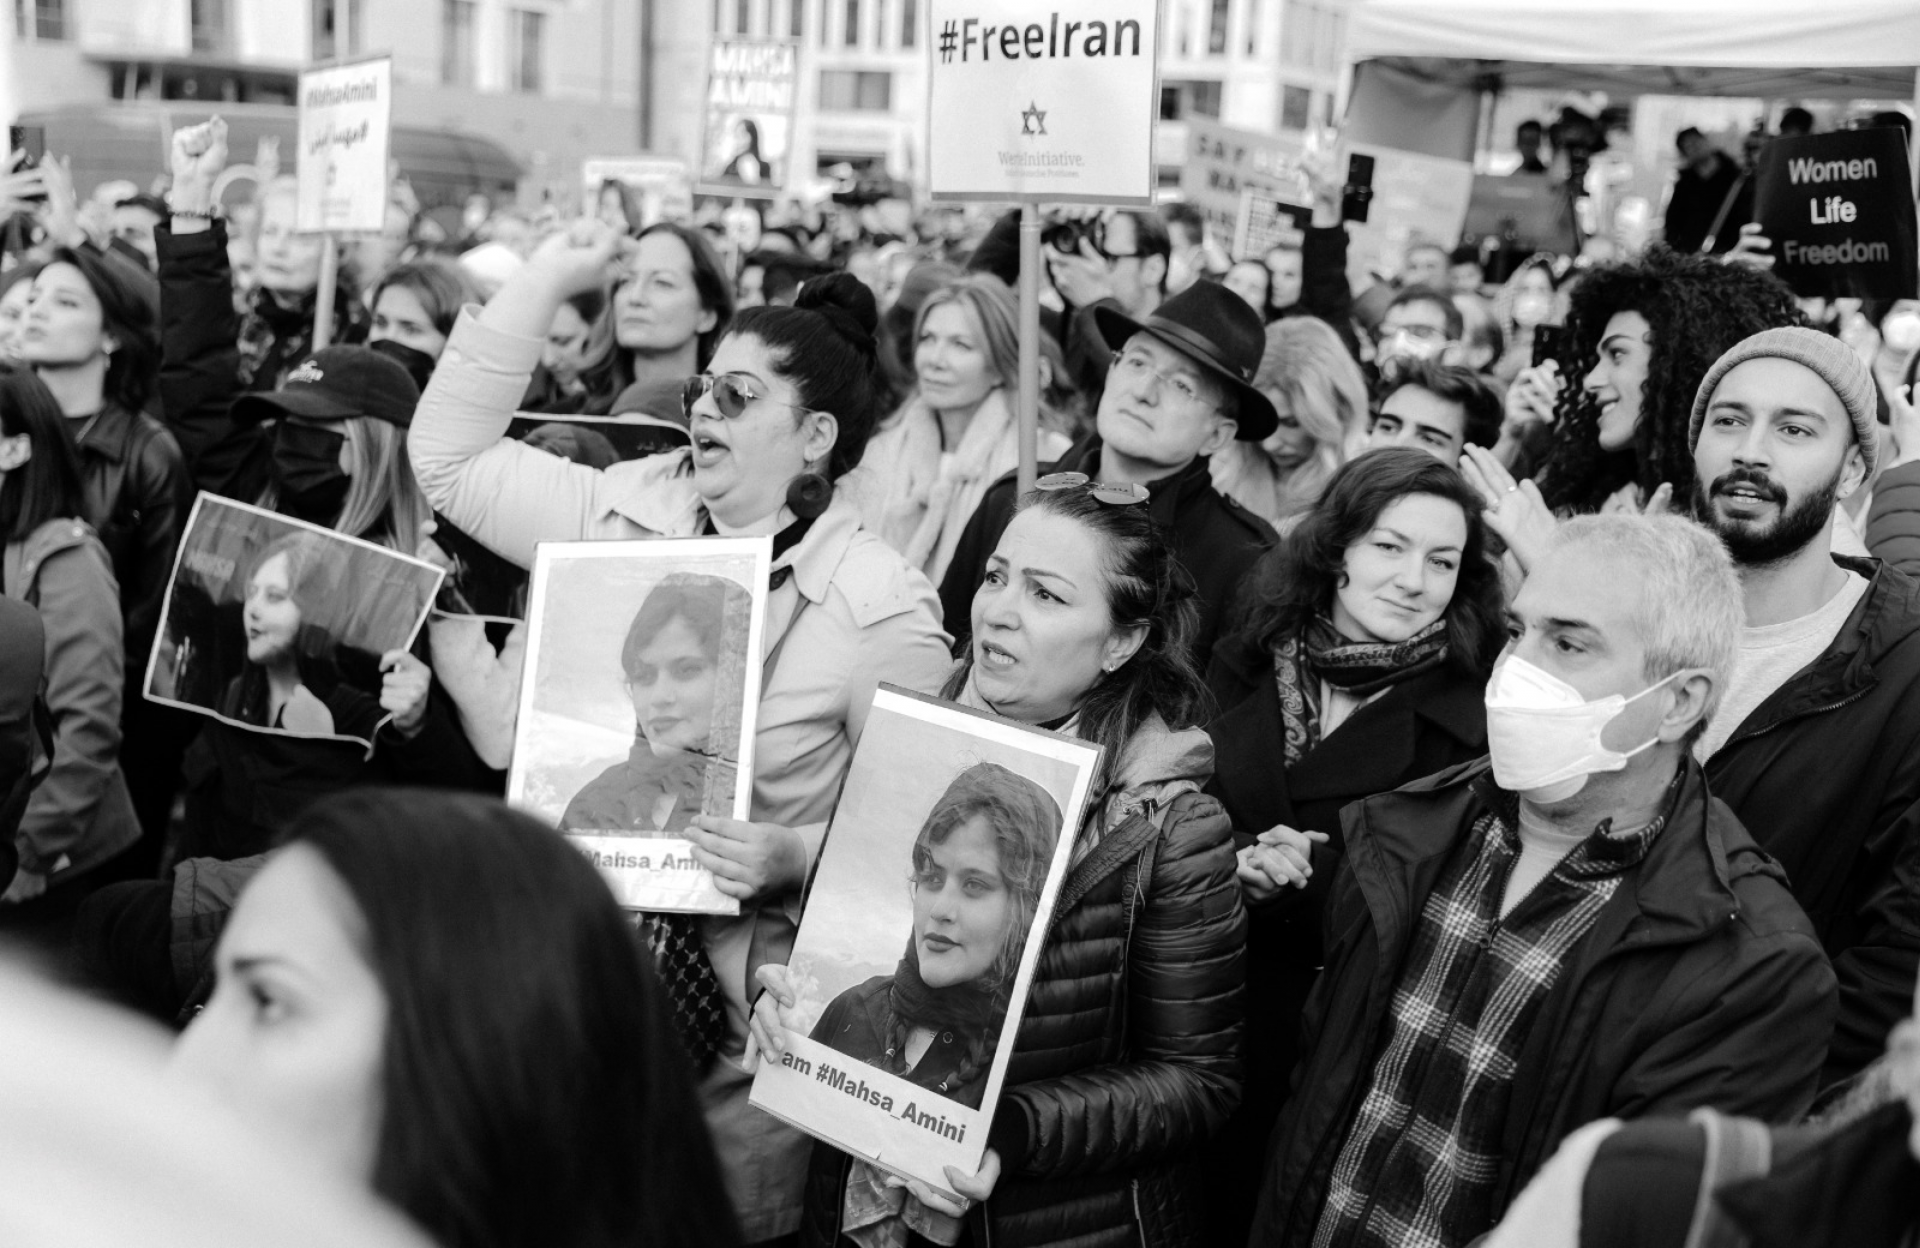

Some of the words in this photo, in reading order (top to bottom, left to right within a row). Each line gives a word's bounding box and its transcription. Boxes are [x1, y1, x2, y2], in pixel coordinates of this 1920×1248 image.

[940, 12, 1140, 64] #FreeIran
[1788, 157, 1878, 185] Women
[1810, 195, 1857, 225] Life
[1783, 237, 1889, 265] Freedom
[782, 1051, 812, 1076] am
[816, 1062, 967, 1144] #Mahsa_Amini
